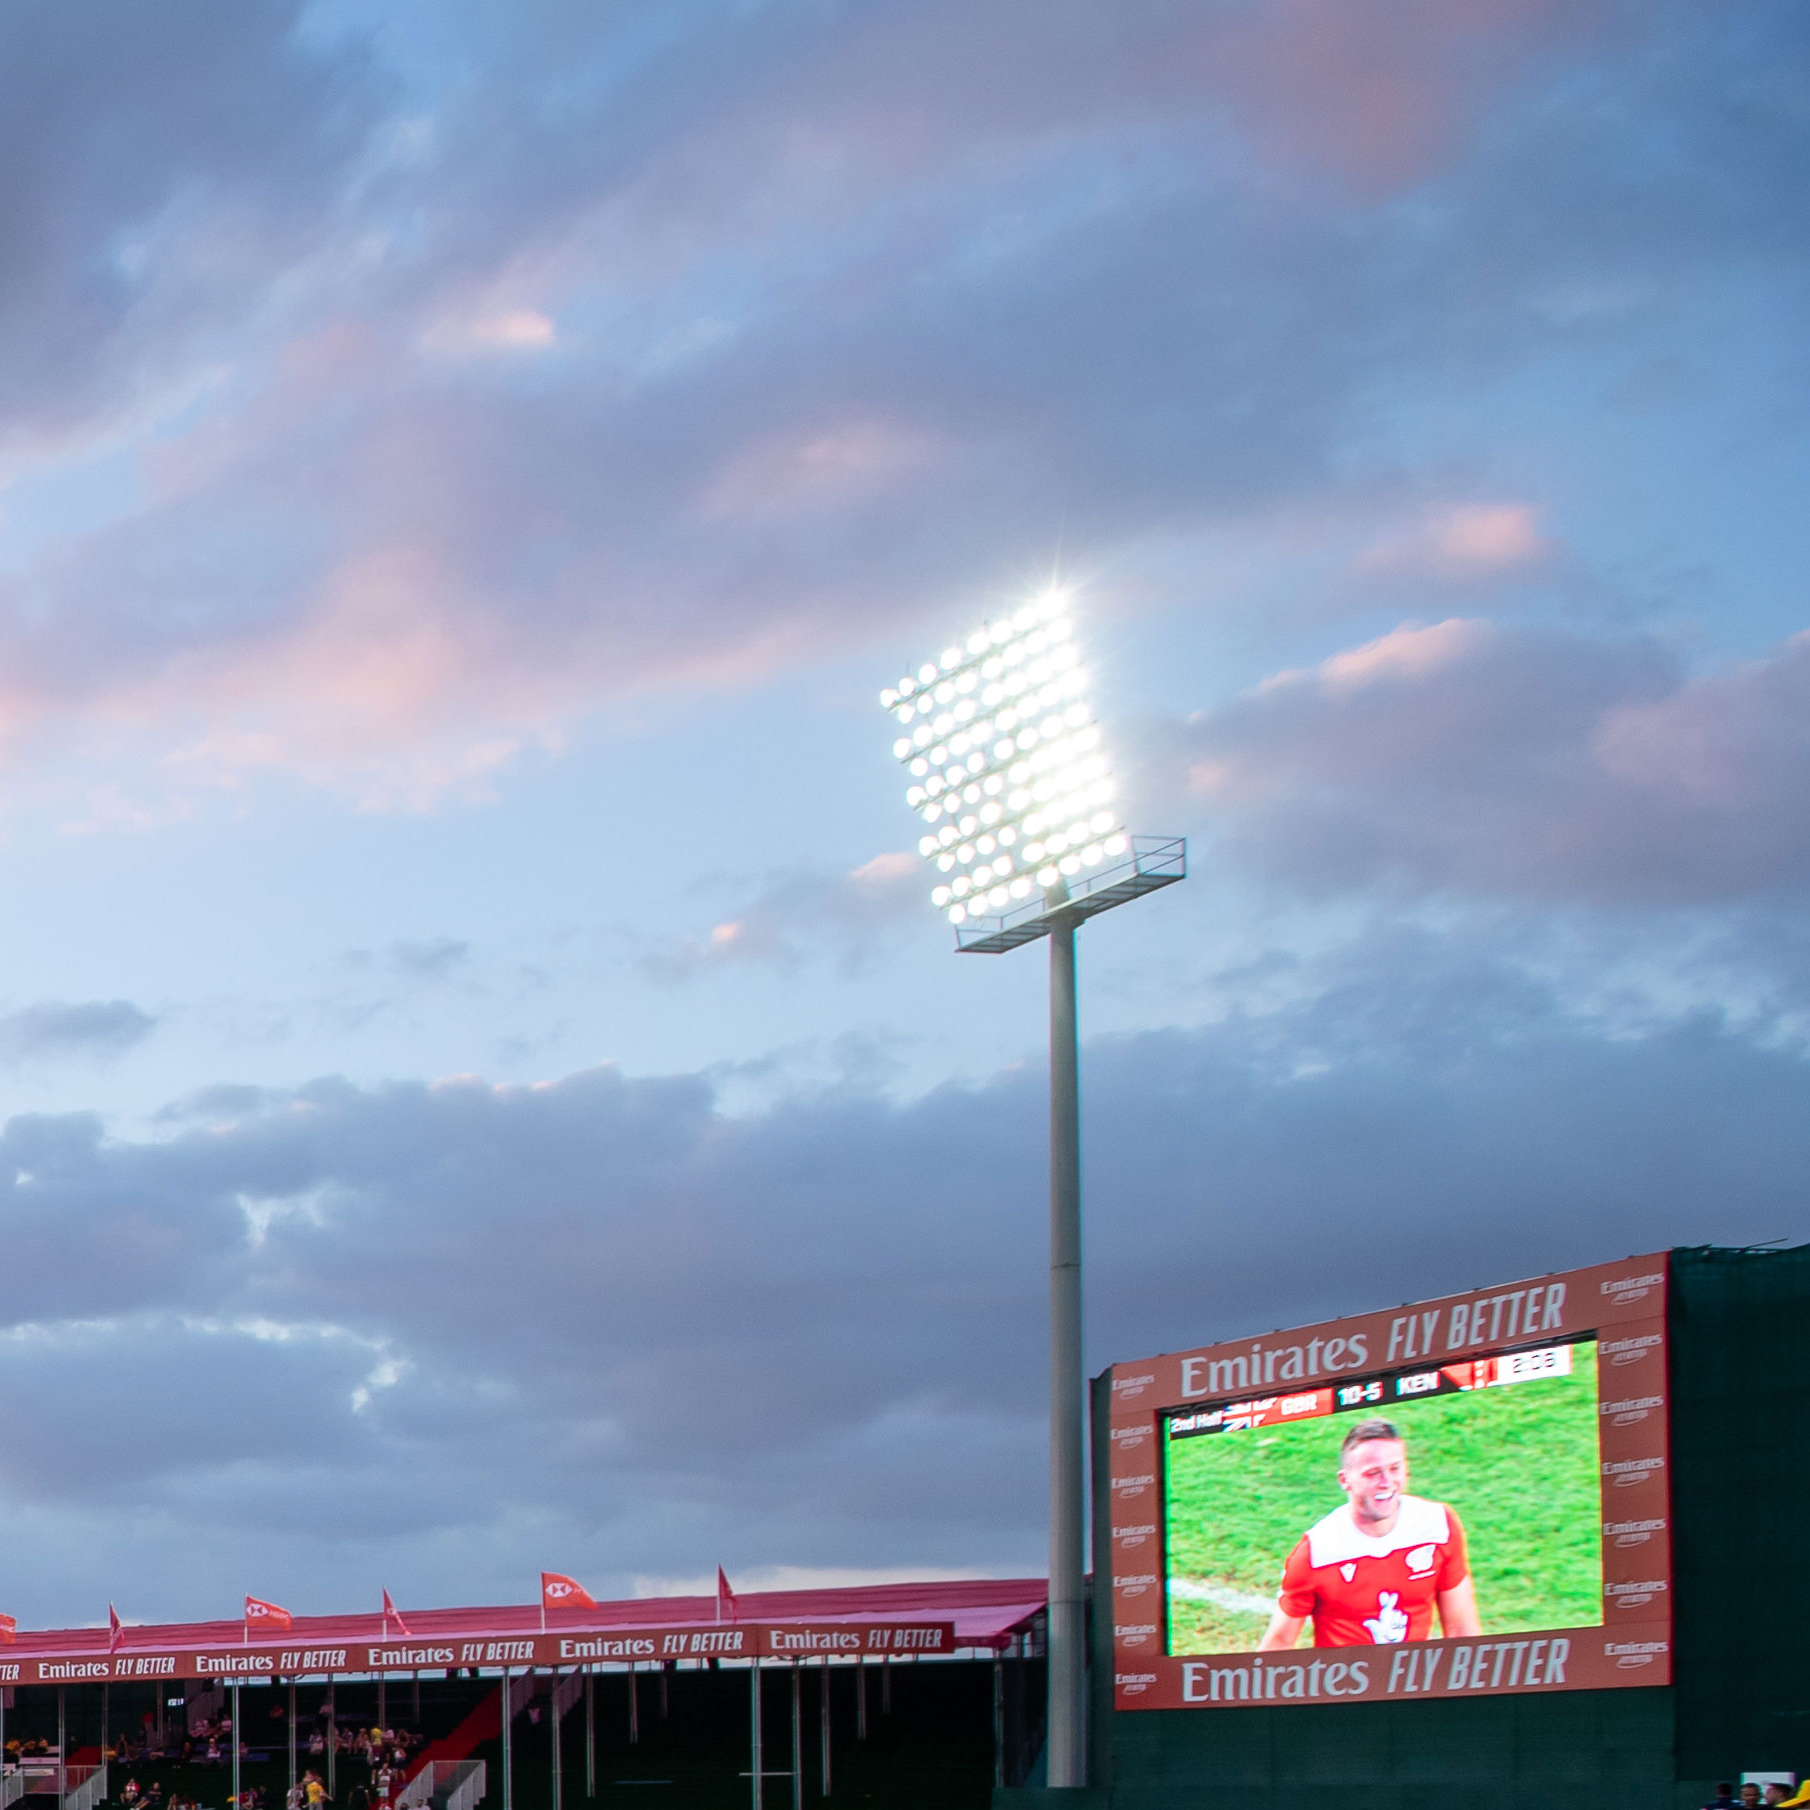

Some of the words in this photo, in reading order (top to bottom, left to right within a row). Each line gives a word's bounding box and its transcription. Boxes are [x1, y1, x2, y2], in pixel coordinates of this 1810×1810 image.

[1180, 1333, 1368, 1398] Emirates
[1387, 1309, 1441, 1363] FLY
[1446, 1283, 1567, 1350] BETTER
[1396, 1371, 1441, 1396] KEN
[1280, 1394, 1317, 1416] GBR
[560, 1638, 654, 1659] Emirates
[663, 1634, 688, 1654] FLY
[690, 1632, 743, 1652] BETTER
[770, 1630, 860, 1650] Emirates
[867, 1629, 891, 1648] FLY
[893, 1629, 942, 1648] BETTER
[196, 1654, 274, 1673] Emirates
[280, 1651, 301, 1669] FLY
[303, 1650, 346, 1668] BETTER
[368, 1647, 454, 1666] Emirates
[461, 1643, 485, 1662] FLY
[486, 1641, 534, 1660] BETTER
[38, 1661, 109, 1679] Emirates
[115, 1658, 135, 1676] FLY
[136, 1657, 176, 1674] BETTER
[1182, 1657, 1369, 1702] Emirates
[1387, 1648, 1444, 1694] FLY
[1447, 1638, 1570, 1690] BETTER
